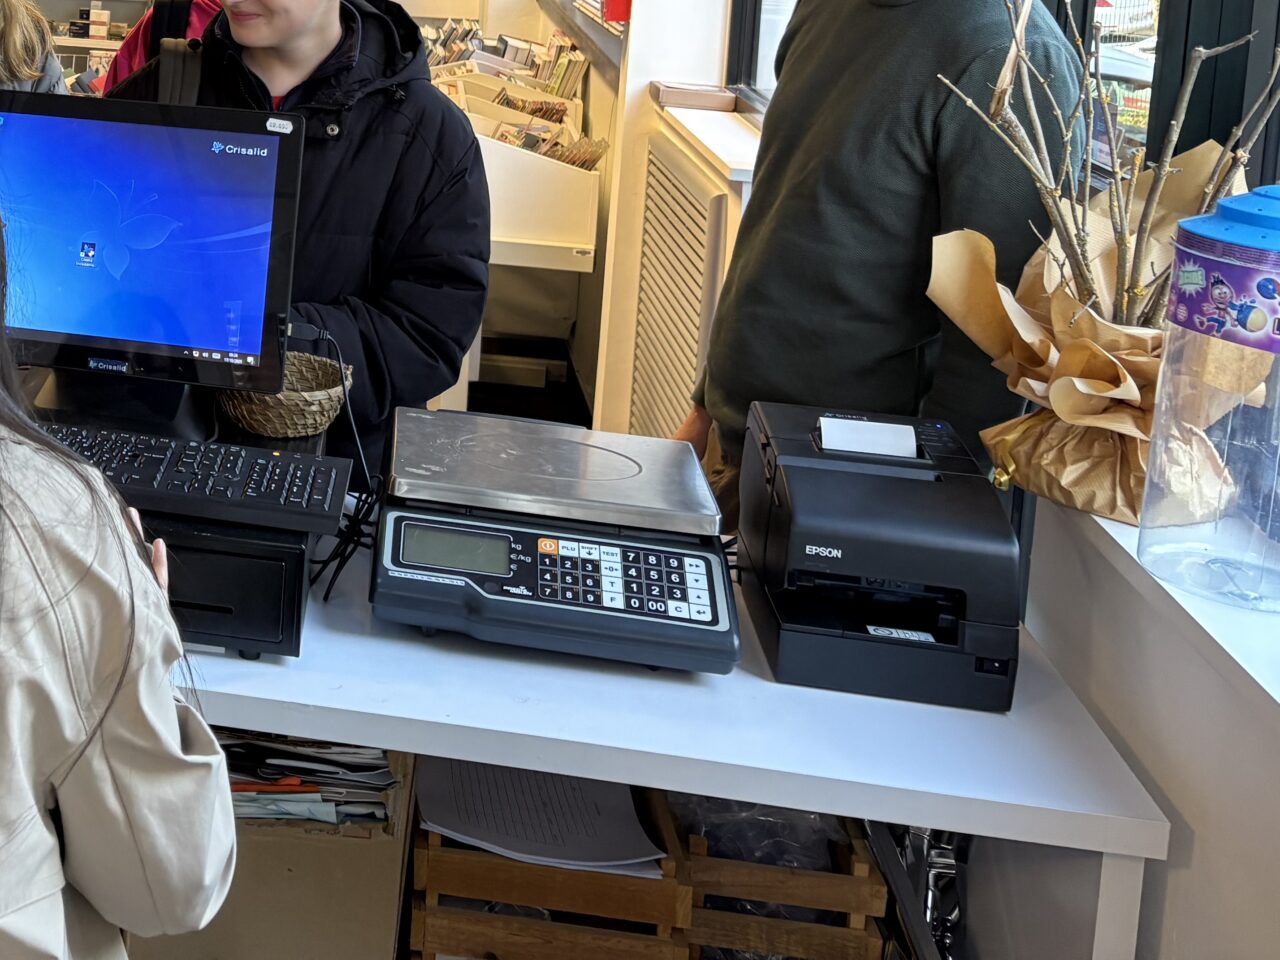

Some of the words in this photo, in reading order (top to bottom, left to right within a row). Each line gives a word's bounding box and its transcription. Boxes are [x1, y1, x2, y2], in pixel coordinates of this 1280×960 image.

[225, 144, 268, 156] Crisalid
[98, 362, 126, 372] Crisalid
[511, 543, 522, 551] kg
[805, 544, 842, 559] EPSON
[510, 553, 532, 563] €/kg
[627, 552, 635, 561] 7
[648, 556, 657, 564] 8
[669, 559, 678, 567] 9
[510, 563, 518, 571] €
[628, 568, 637, 577] 4
[650, 571, 658, 579] 5
[671, 574, 679, 582] 6
[631, 583, 637, 592] 1
[651, 586, 660, 595] 2
[673, 589, 681, 598] 3
[566, 591, 573, 599] 8
[586, 594, 594, 602] 9
[631, 599, 639, 607] 0
[648, 601, 665, 611] 00
